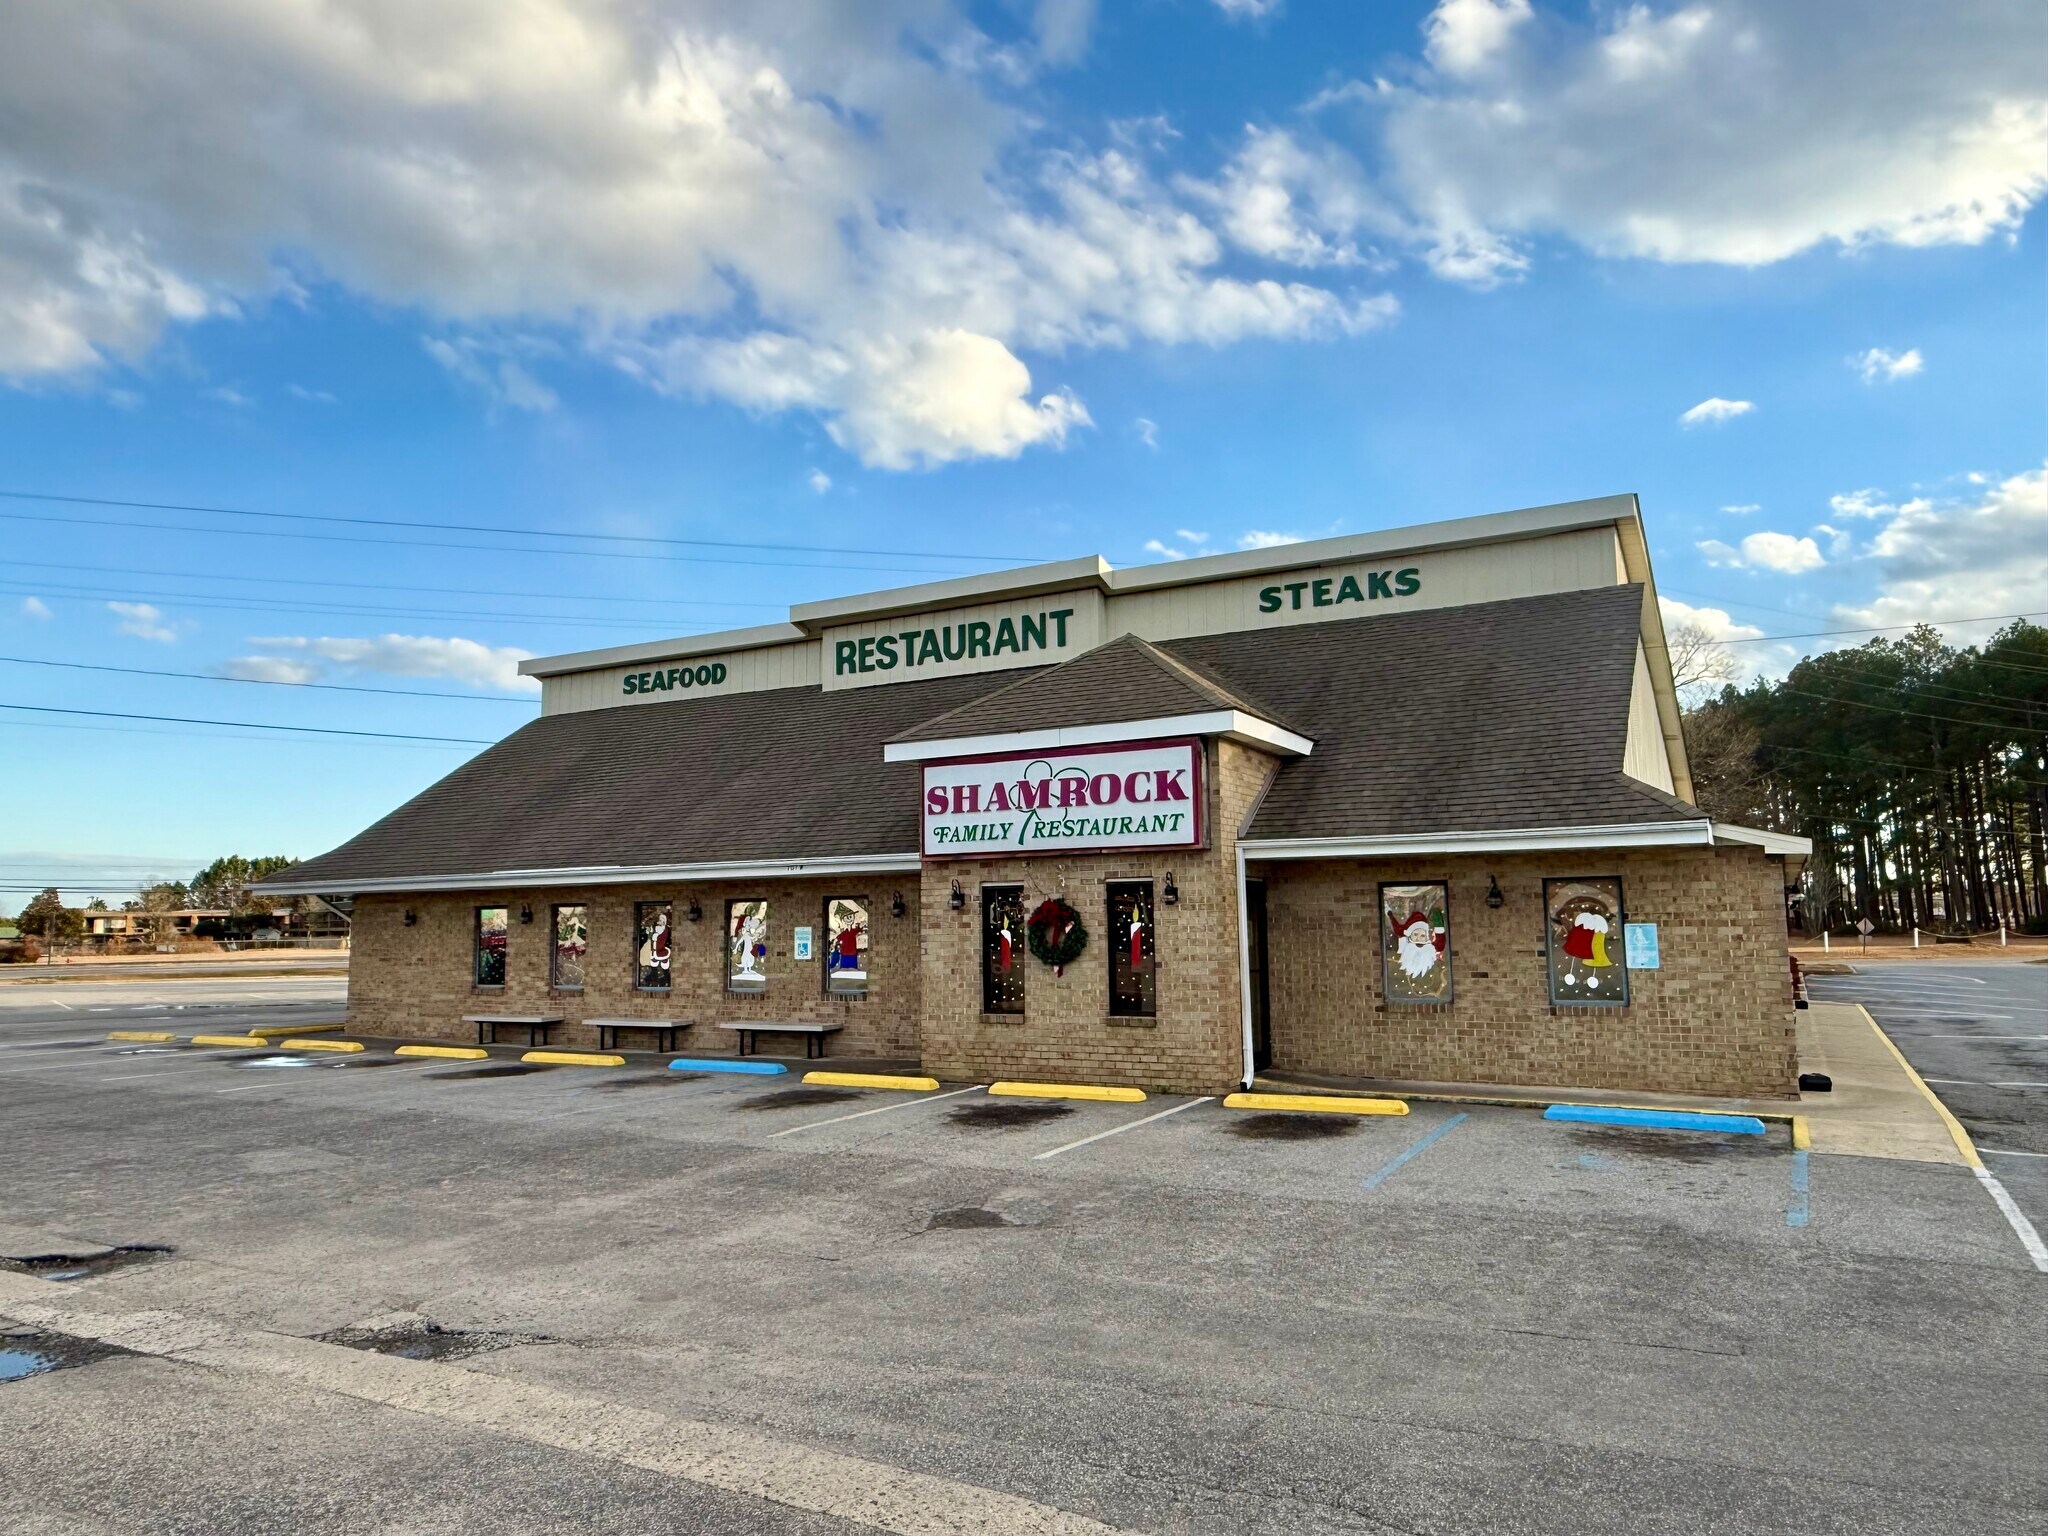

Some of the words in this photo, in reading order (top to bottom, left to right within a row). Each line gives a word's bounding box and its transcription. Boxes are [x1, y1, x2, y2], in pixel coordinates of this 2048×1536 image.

[1259, 568, 1421, 613] STEAKS
[836, 608, 1074, 675] RESTAURANT
[623, 663, 727, 695] SEAFOOD
[927, 769, 1189, 815] SHAMROCK
[933, 822, 1013, 843] FAMILY
[1032, 814, 1185, 839] RESTAURANT
